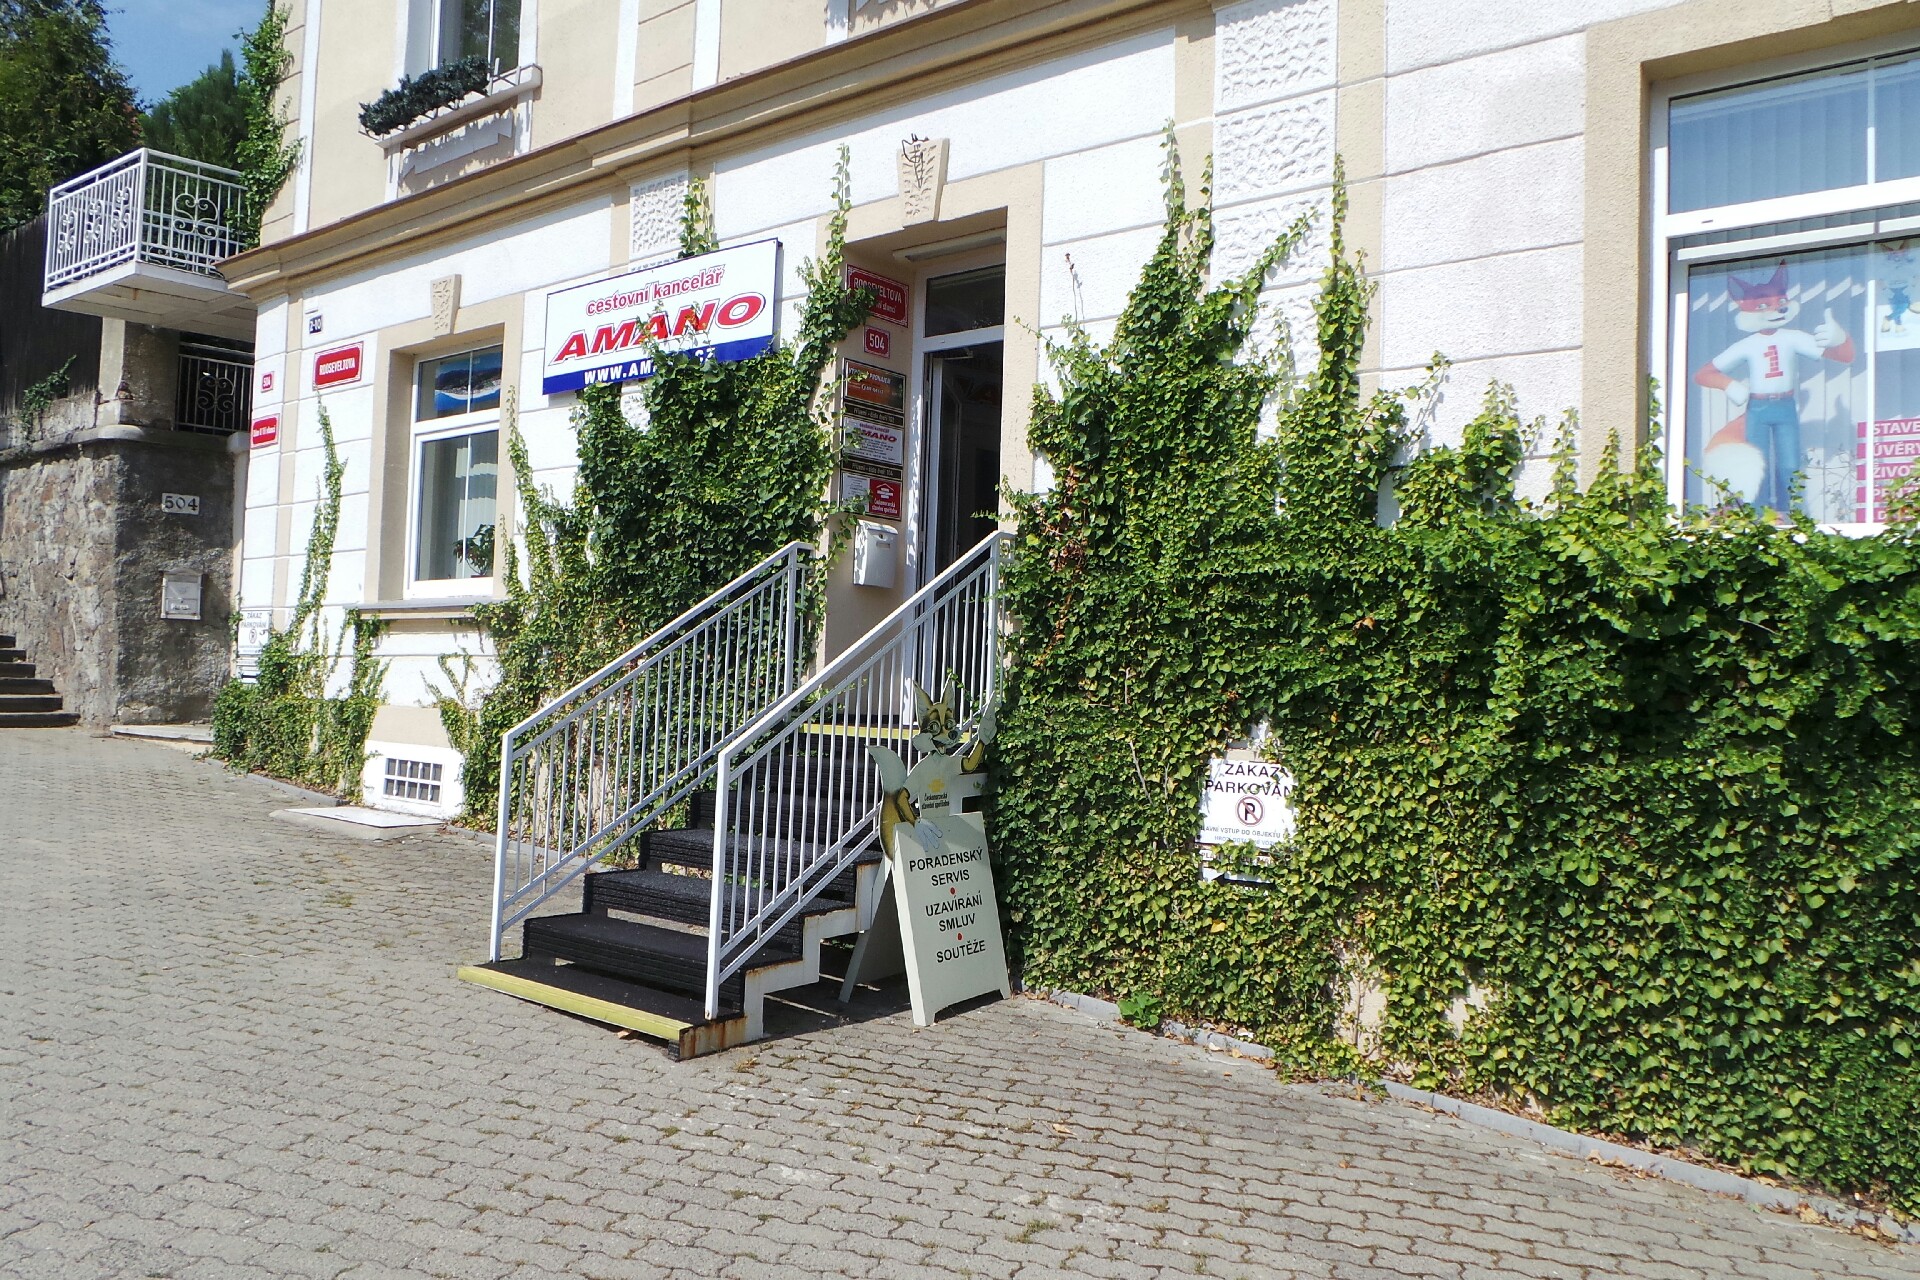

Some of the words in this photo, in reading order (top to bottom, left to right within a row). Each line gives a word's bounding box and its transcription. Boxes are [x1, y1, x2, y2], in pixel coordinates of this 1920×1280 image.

[587, 286, 650, 315] cestovní
[653, 267, 724, 299] kancelář
[552, 293, 766, 362] AMANO
[869, 333, 885, 350] 504
[319, 357, 356, 375] ROOSEVELTOVA
[862, 430, 897, 442] MANO
[165, 495, 198, 511] 504
[1225, 762, 1281, 777] ZÁKAZ
[1205, 779, 1291, 797] PARKOVÁN
[909, 846, 983, 872] PORADENSKÝ
[931, 869, 970, 886] SERVIS
[925, 890, 983, 917] UZAVÍRÁNÍ
[939, 913, 975, 932] SMLUV
[936, 939, 986, 963] SOUTĚŽE
